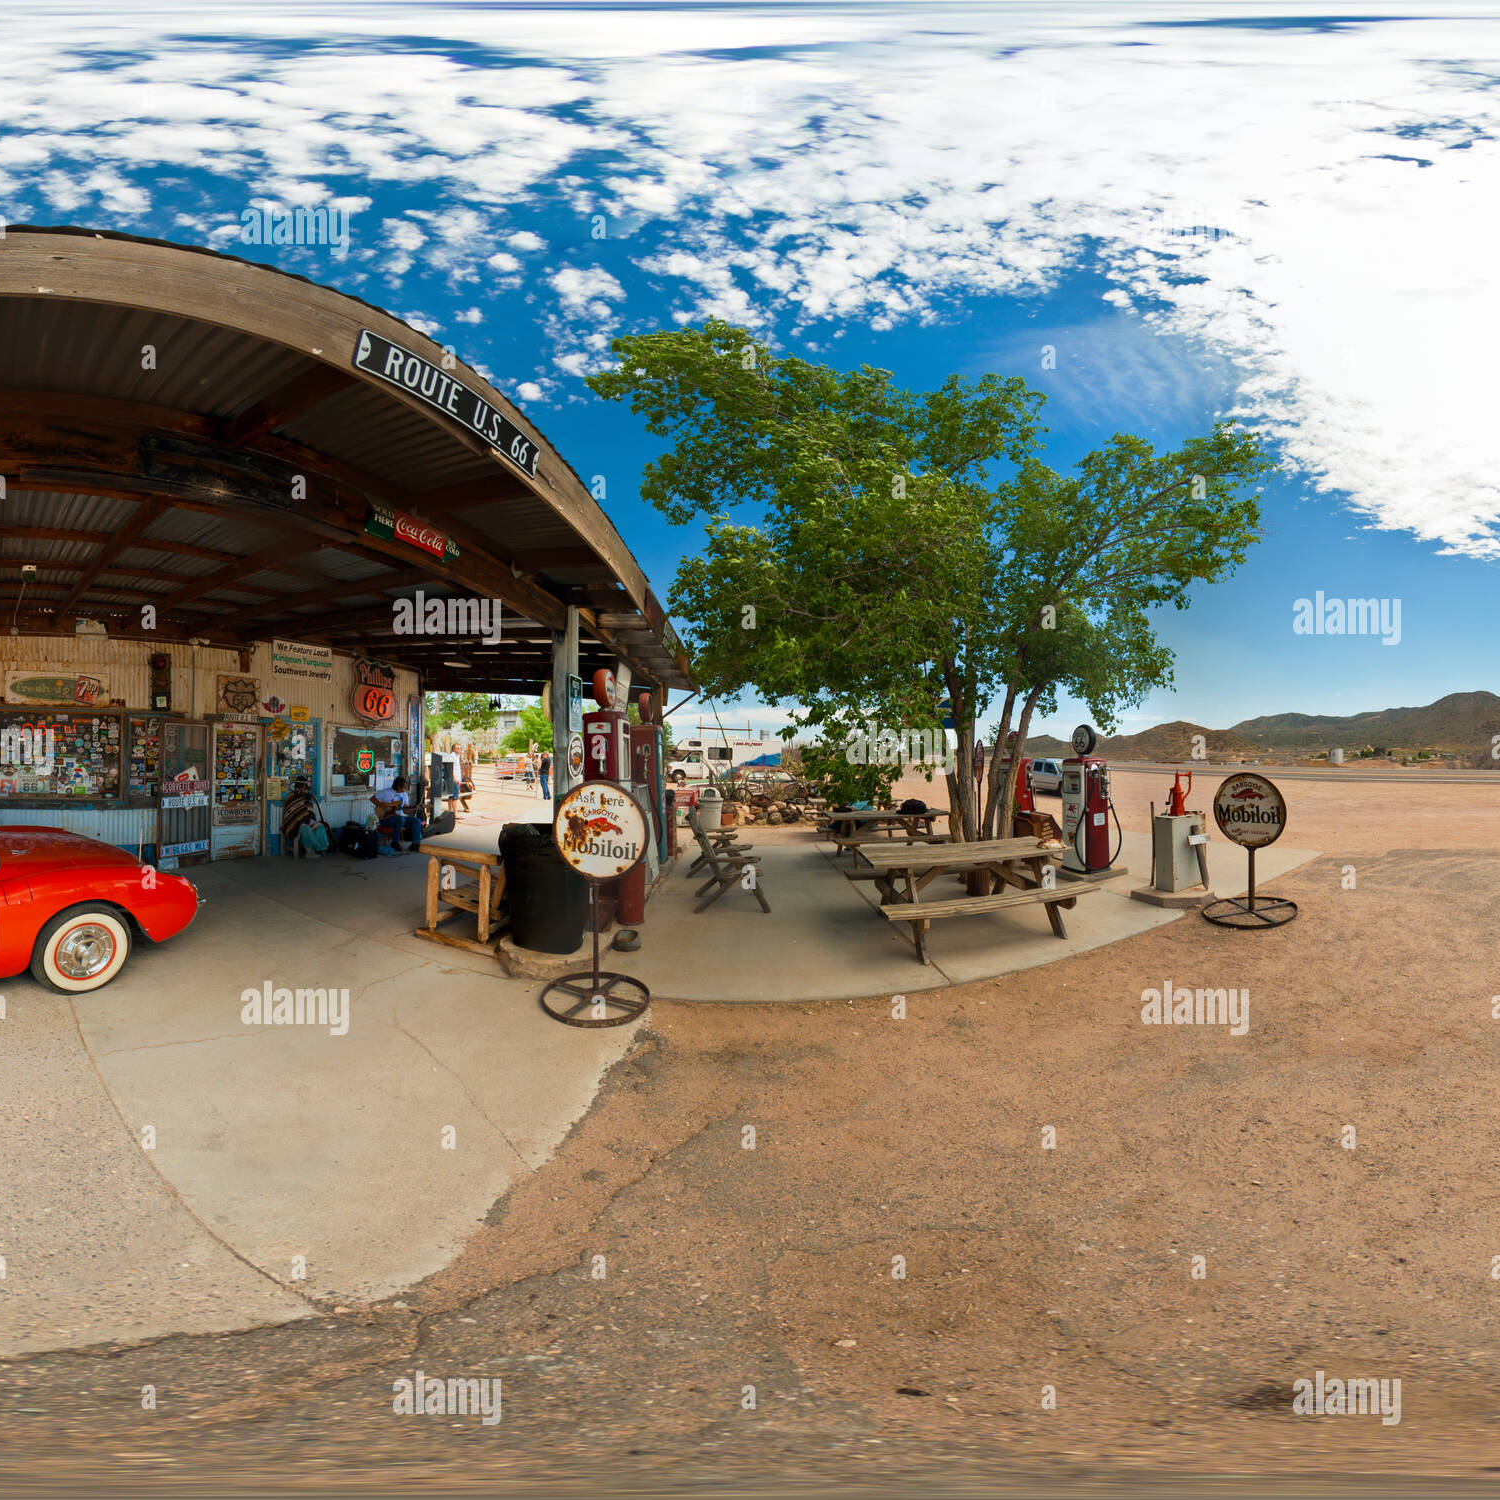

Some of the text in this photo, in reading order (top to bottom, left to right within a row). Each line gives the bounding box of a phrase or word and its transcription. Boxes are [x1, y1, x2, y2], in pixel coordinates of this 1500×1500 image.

[384, 346, 530, 465] ROUTE U.S. 66
[374, 512, 395, 529] HERE
[277, 642, 329, 658] We Feature Local
[273, 653, 302, 665] Kingman
[274, 665, 332, 681] Southwest Jewelry
[360, 663, 393, 689] Phillips
[364, 689, 392, 718] 66
[1074, 738, 1085, 749] 66
[359, 759, 371, 770] 66
[22, 782, 38, 792] 66
[168, 797, 184, 807] ROUTE
[197, 796, 205, 805] 66
[575, 791, 596, 804] Ask
[582, 808, 619, 822] GARGOYLE
[1218, 803, 1280, 825] Mobiloil
[193, 840, 206, 850] MILE
[563, 833, 637, 860] Mobiloil
